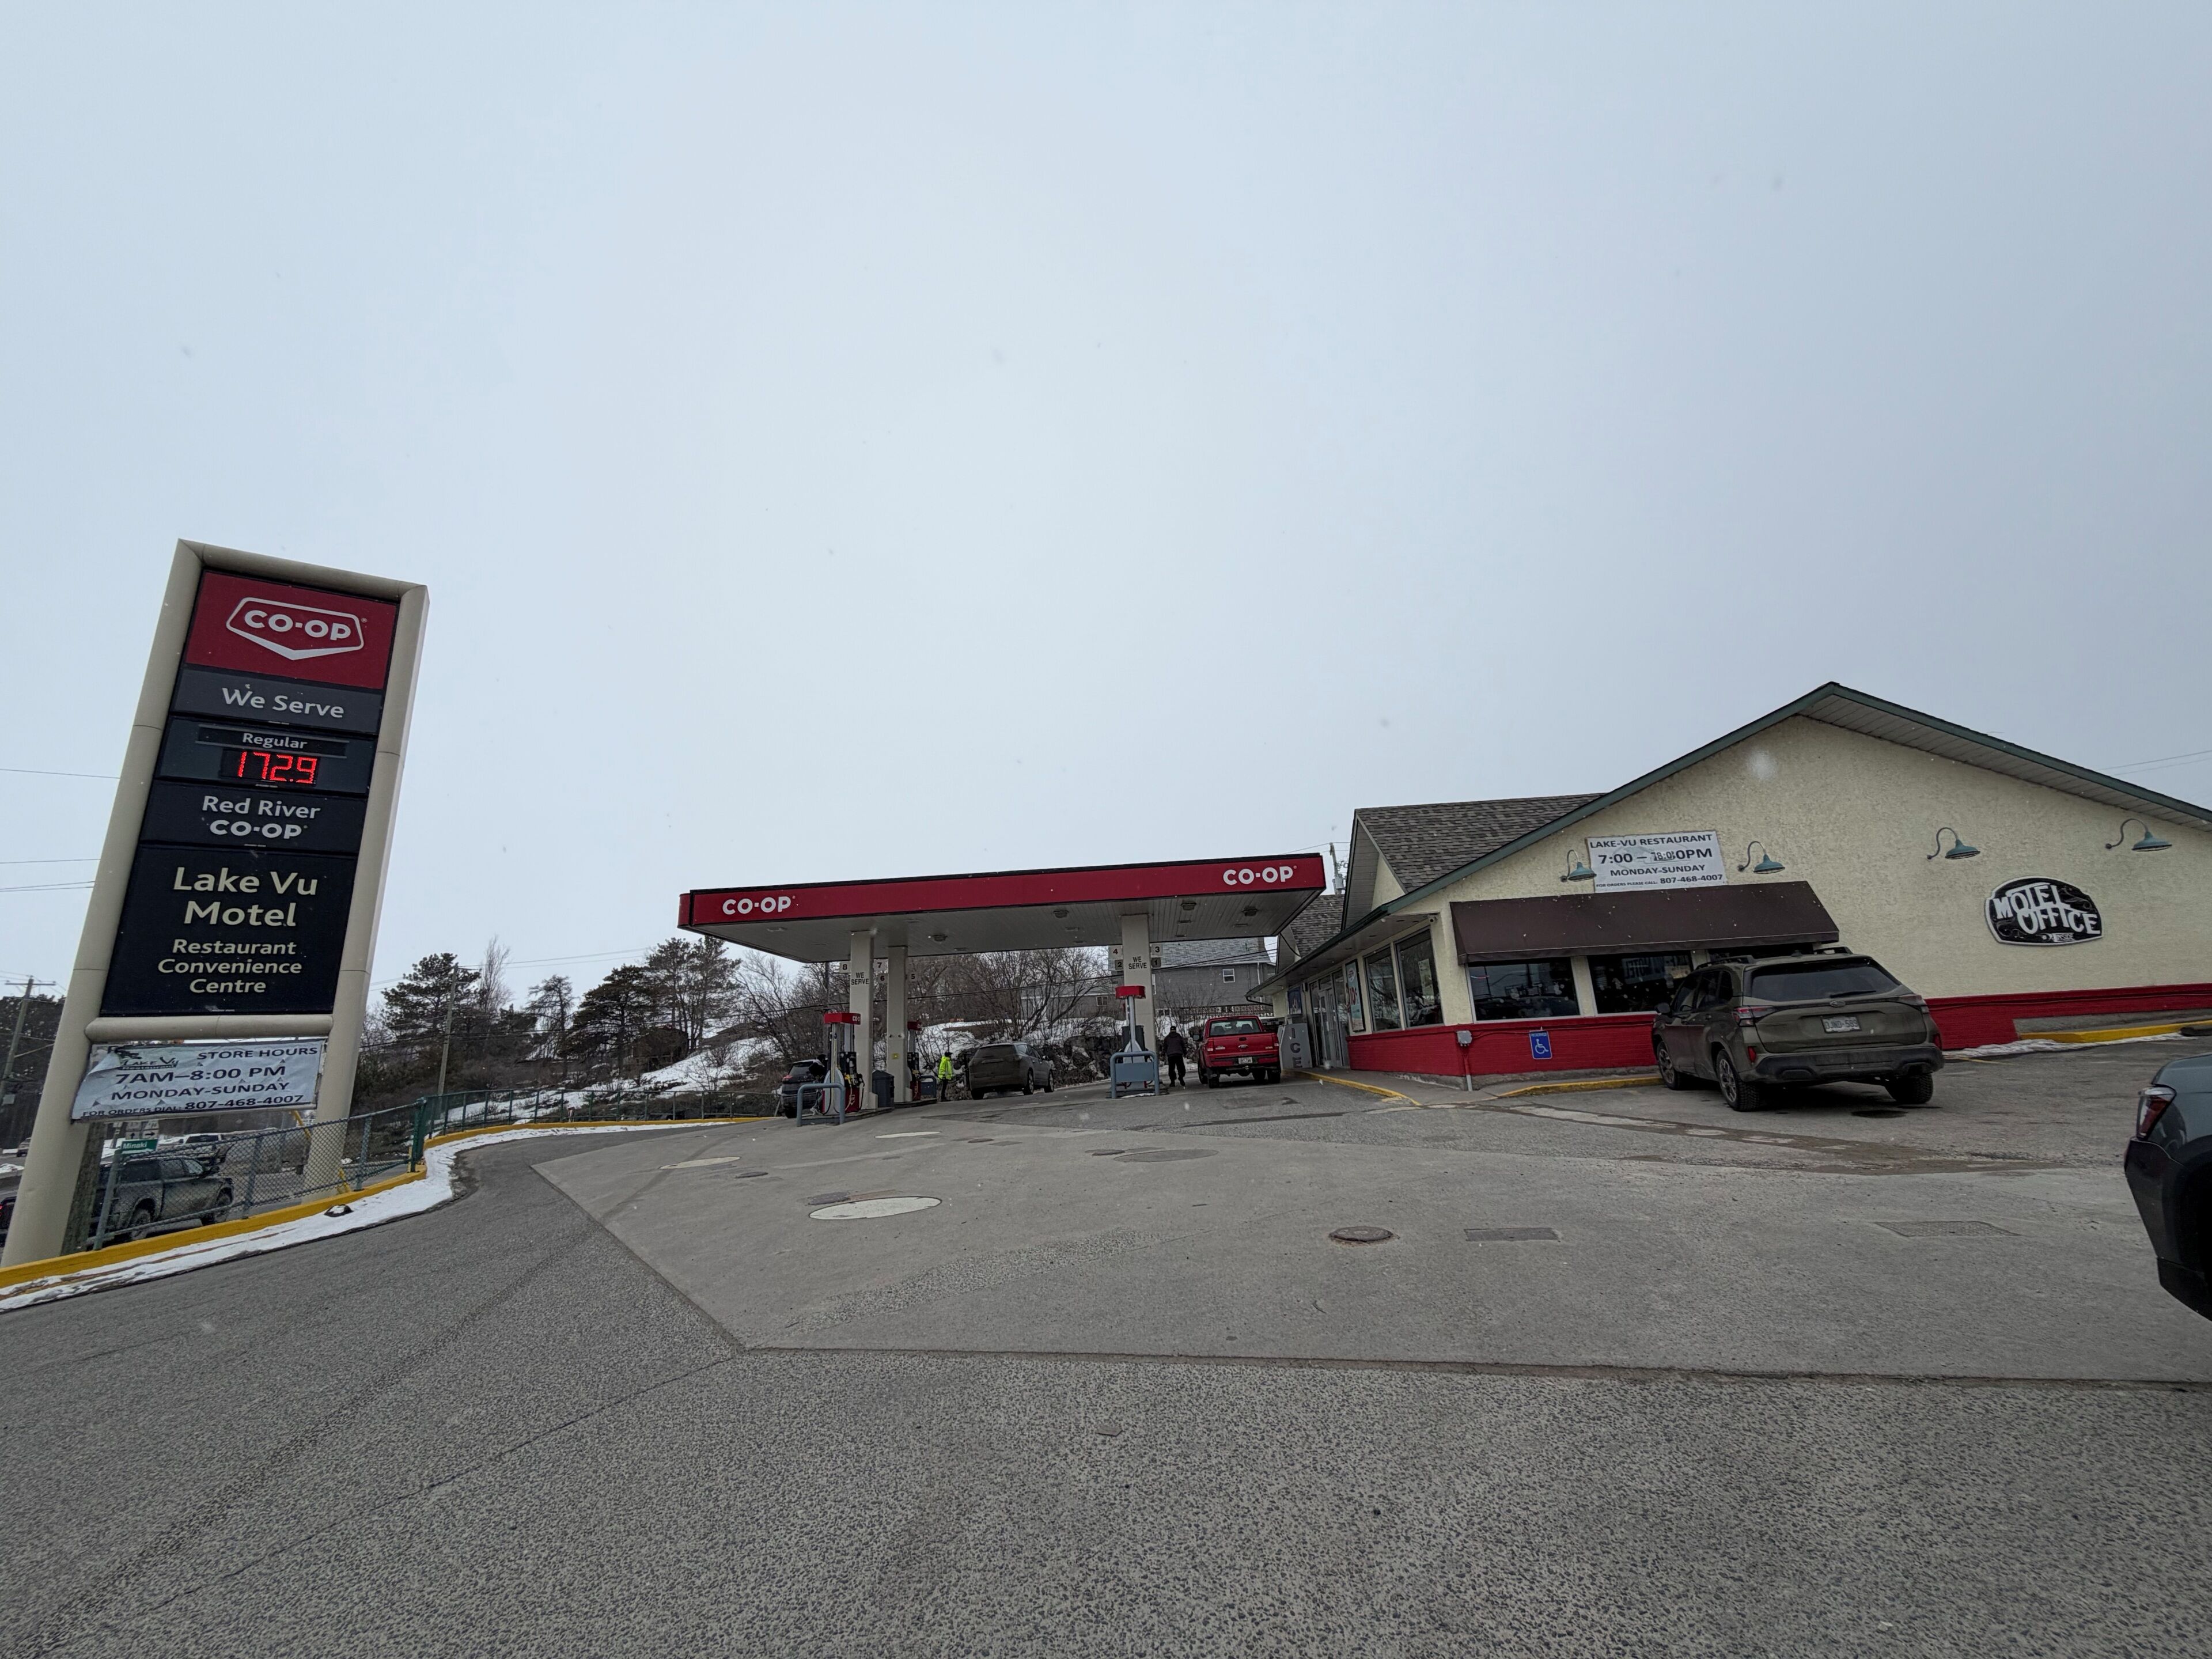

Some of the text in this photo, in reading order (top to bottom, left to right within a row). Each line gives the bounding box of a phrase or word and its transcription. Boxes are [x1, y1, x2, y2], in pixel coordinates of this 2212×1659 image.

[244, 609, 351, 641] CO-OP
[222, 687, 344, 718] We Serve
[243, 733, 308, 749] Regular
[237, 751, 317, 784] 172.9
[202, 796, 321, 819] Red River
[210, 820, 302, 839] CO-OP
[1590, 834, 1713, 849] LAKE-VU RESTAURANT
[1598, 853, 1633, 864] 7:00
[1223, 866, 1293, 886] CO-OP
[1610, 865, 1706, 877] MONDAY-SUNDAY
[1660, 874, 1723, 885] 807-468-4007
[173, 867, 318, 895] Lake Vu
[722, 896, 791, 915] CO-OP
[1993, 882, 2071, 919] MOTEL
[184, 900, 297, 926] Motel
[2017, 902, 2101, 934] OFFICE
[172, 939, 297, 955] Restaurant
[158, 959, 302, 974] Convenience
[190, 979, 266, 993] Centre
[197, 1047, 317, 1060] STORE HOURS
[1290, 1028, 1303, 1068] ICE
[248, 1066, 286, 1077] PM
[111, 1082, 290, 1101] MONDAY-SUNDAY
[108, 1107, 151, 1116] ORDERS
[184, 1095, 304, 1111] 807-468-4007
[123, 1141, 147, 1149] Minaki
